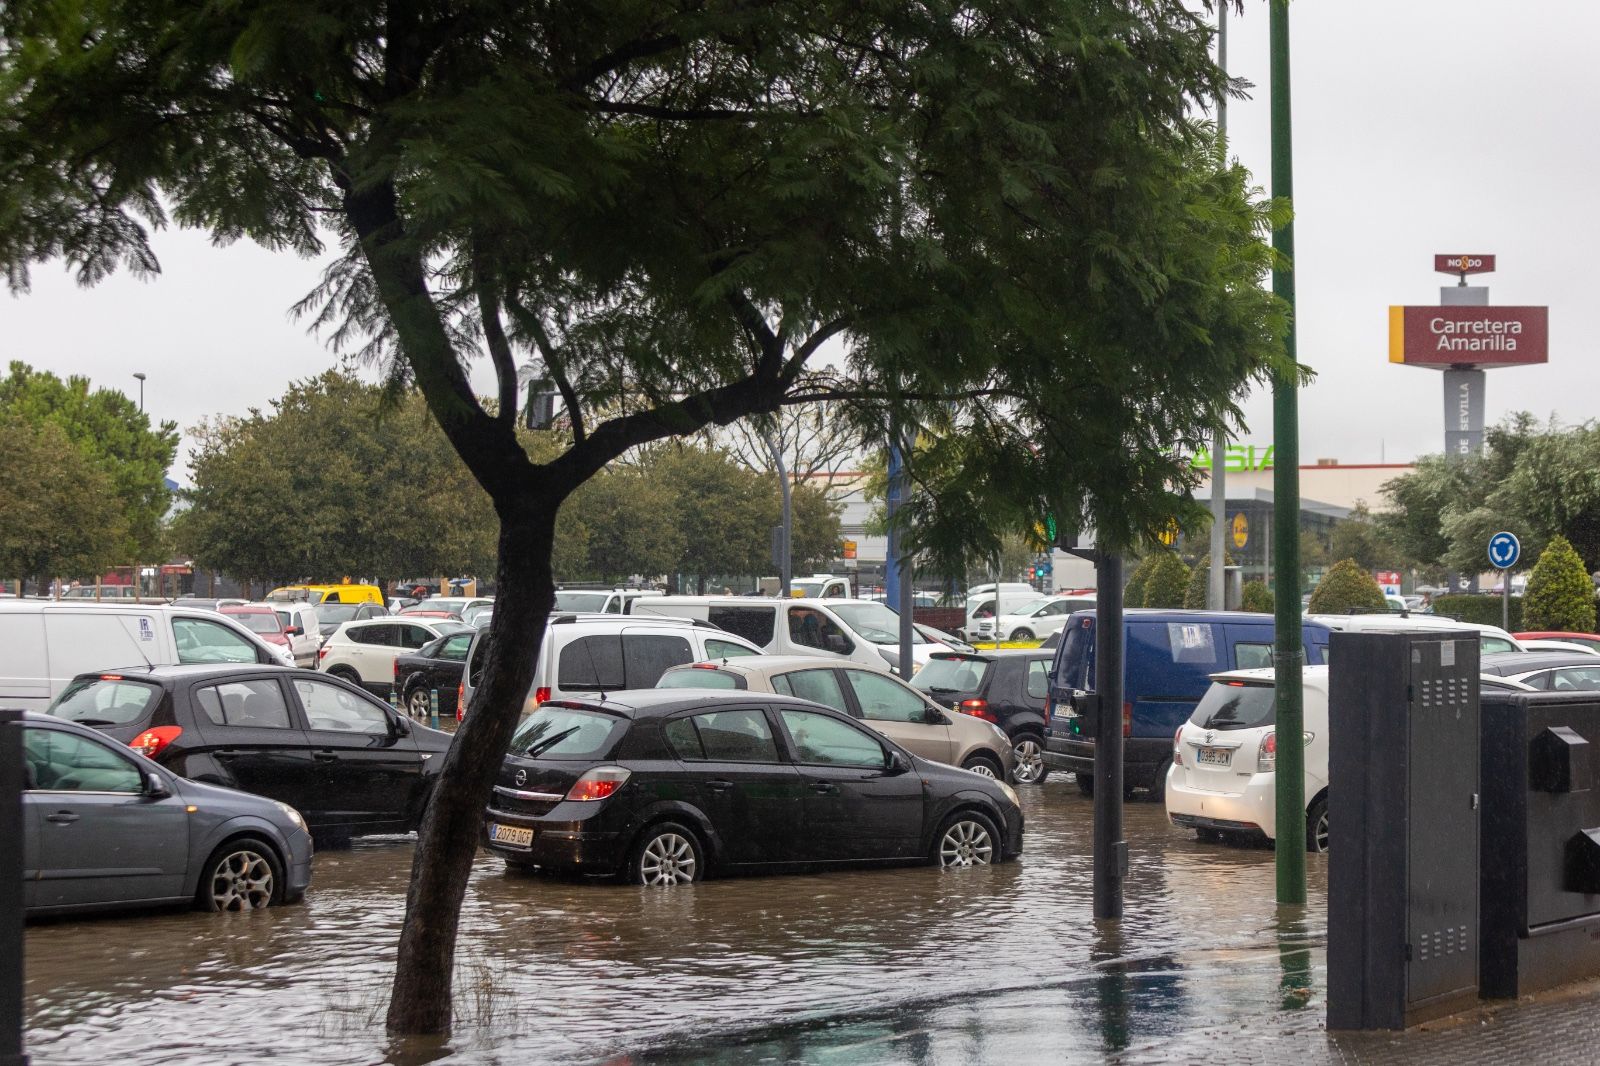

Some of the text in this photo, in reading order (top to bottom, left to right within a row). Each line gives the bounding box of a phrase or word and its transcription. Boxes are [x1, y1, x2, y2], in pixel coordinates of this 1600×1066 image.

[1430, 317, 1522, 334] Carretera
[1437, 334, 1517, 351] Amarilla
[1459, 383, 1469, 431] SEVILLA
[496, 827, 516, 841] 2079
